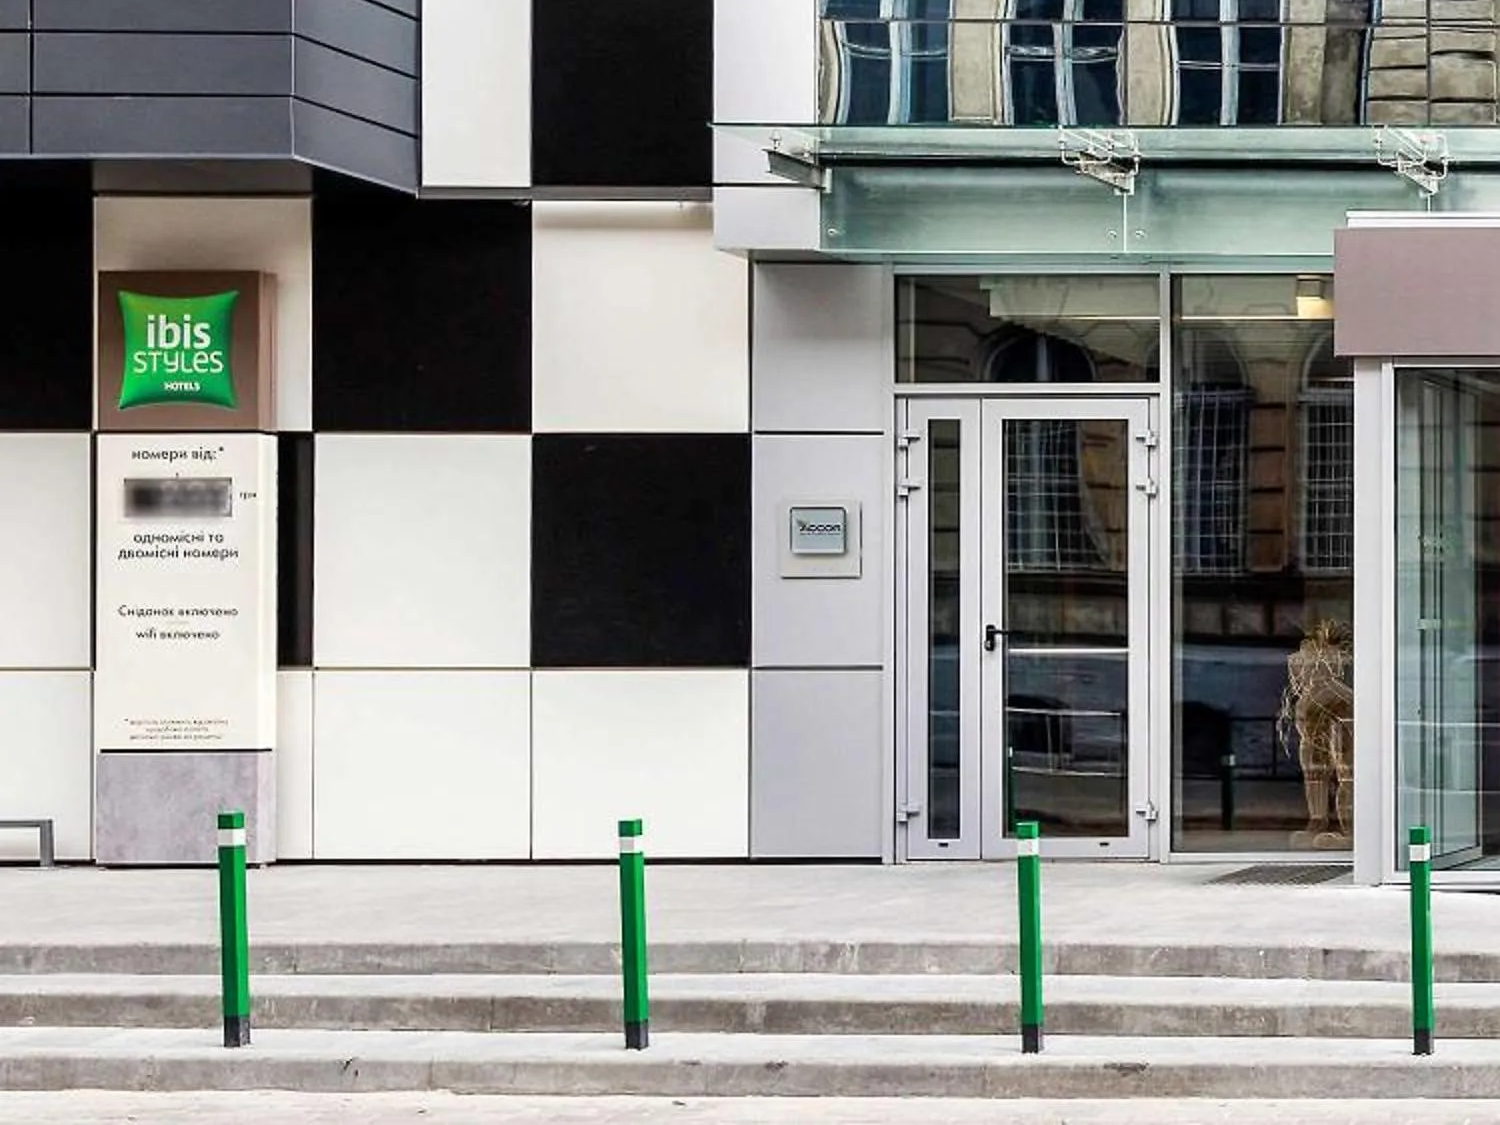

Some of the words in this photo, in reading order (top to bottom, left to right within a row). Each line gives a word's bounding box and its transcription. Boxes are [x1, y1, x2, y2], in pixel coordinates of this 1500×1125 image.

[146, 313, 212, 350] ibis
[164, 380, 201, 392] HOTELS
[131, 449, 188, 463] номери
[183, 548, 240, 562] номери
